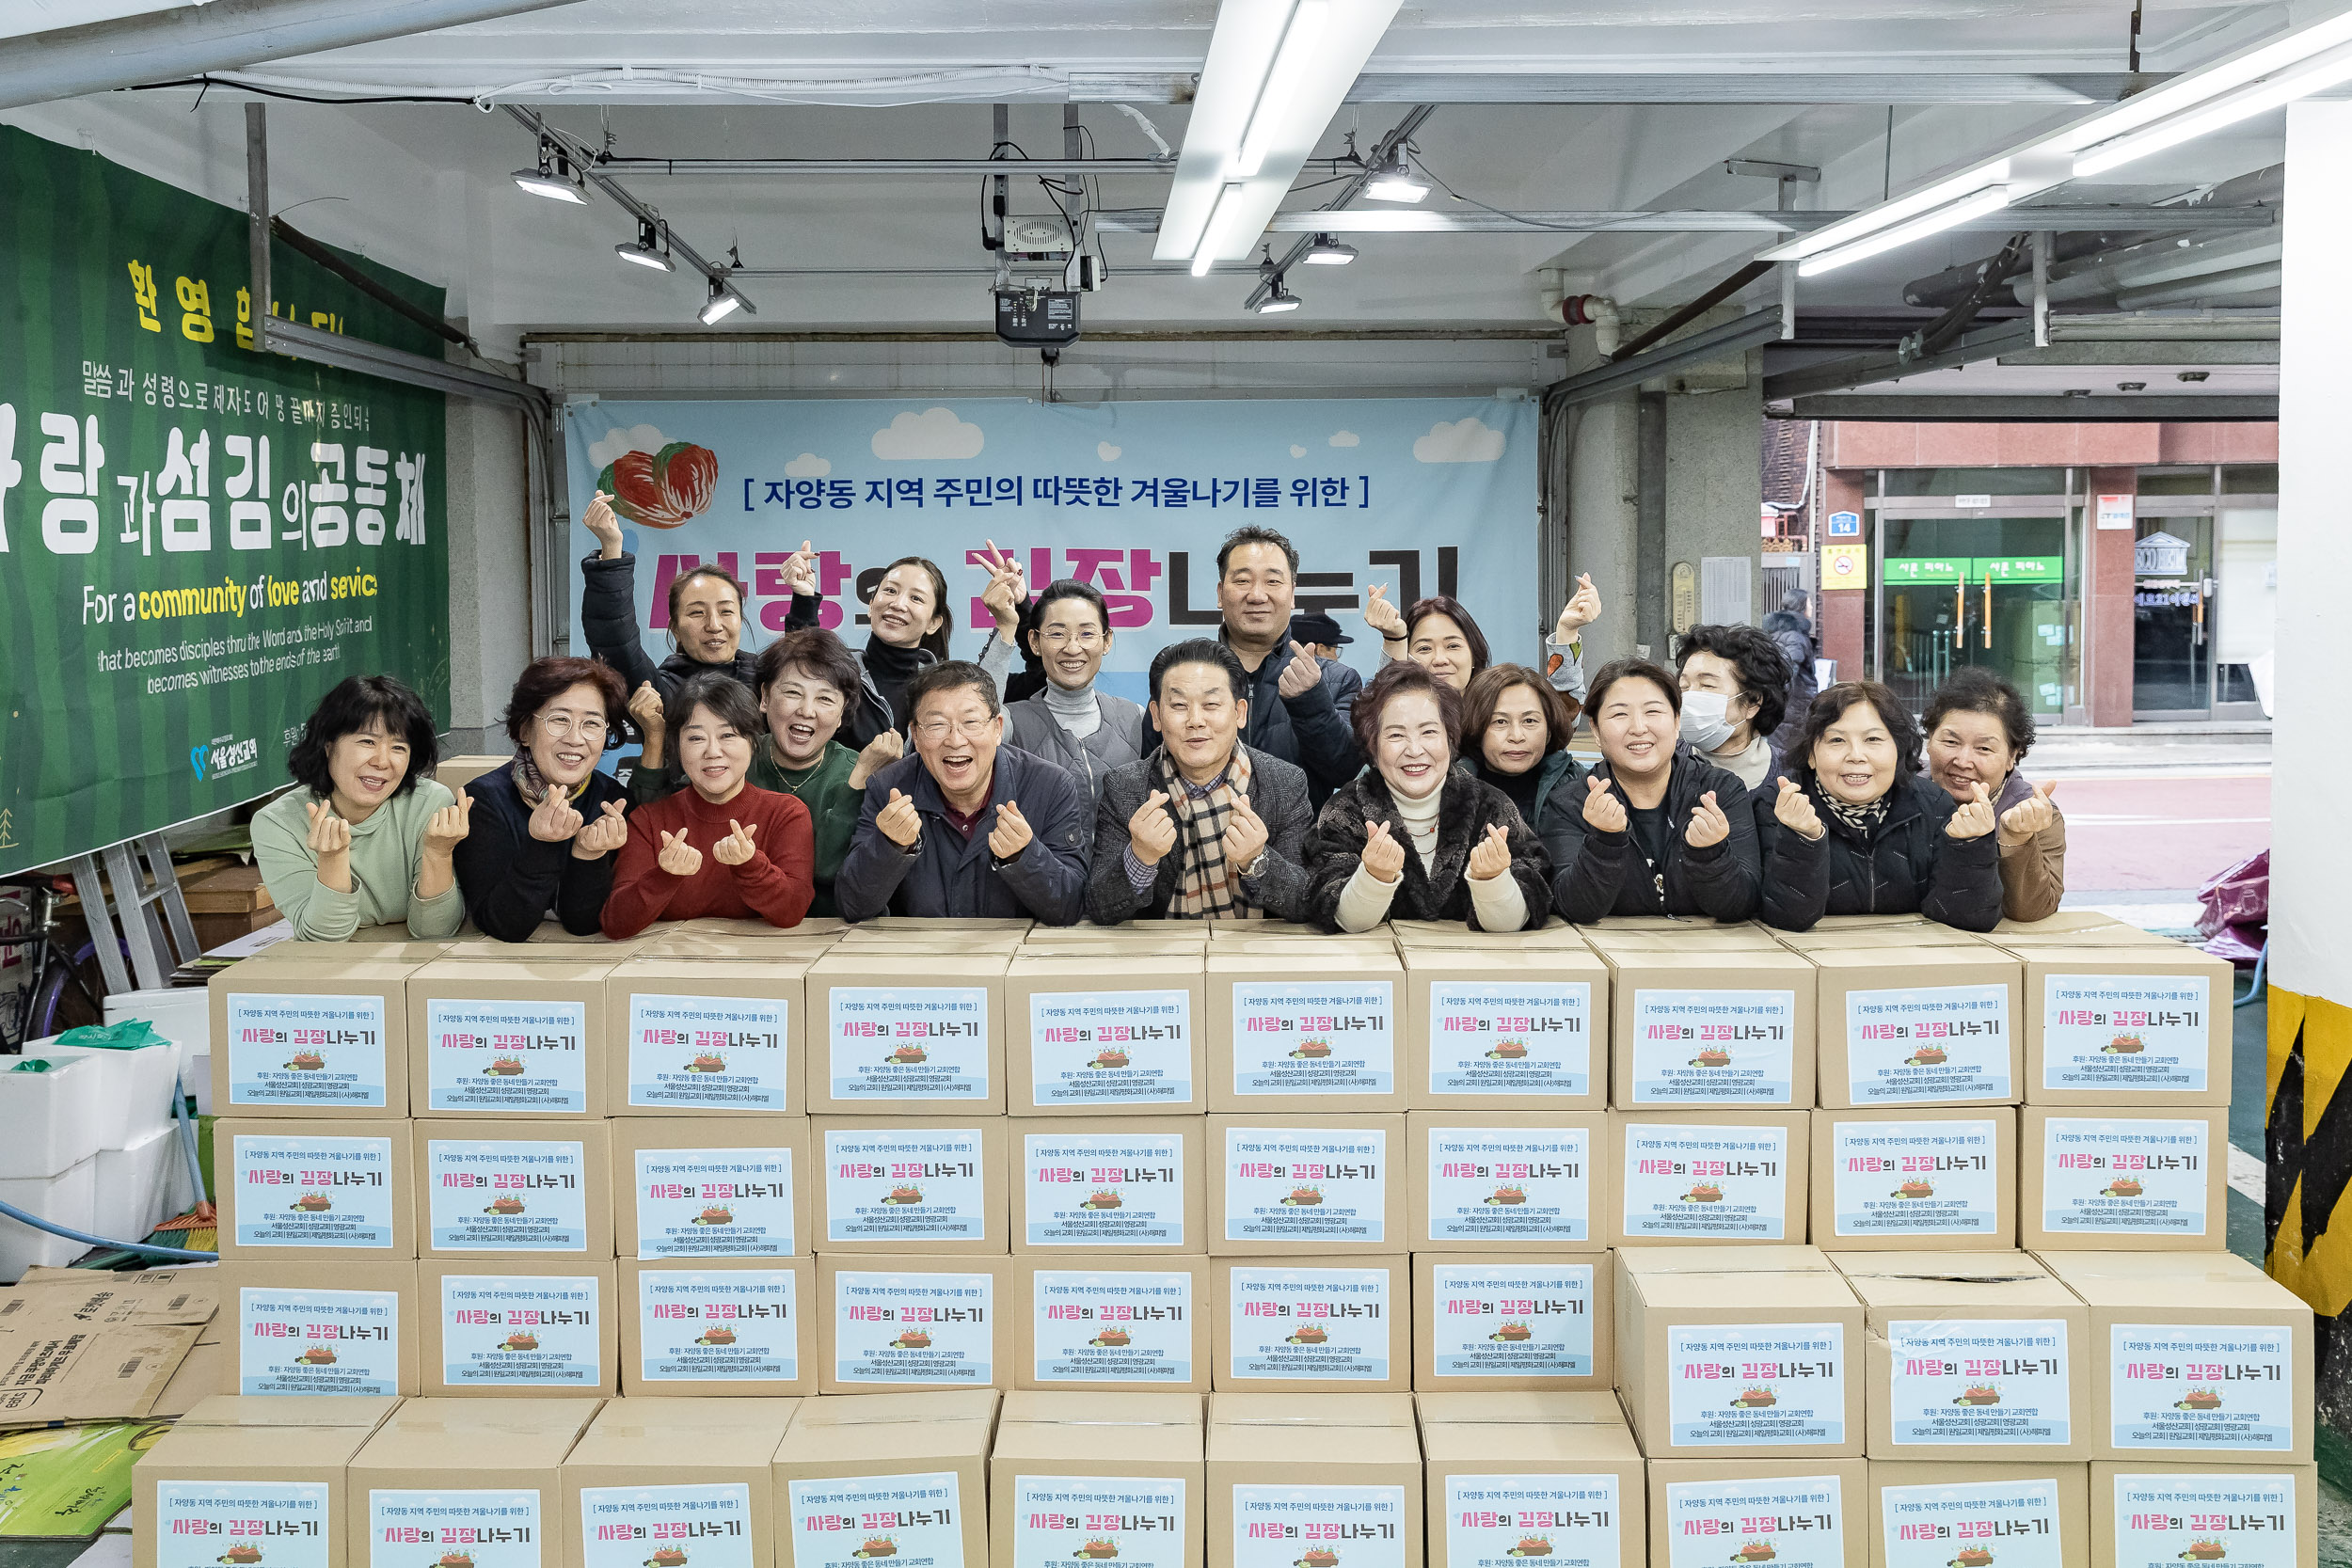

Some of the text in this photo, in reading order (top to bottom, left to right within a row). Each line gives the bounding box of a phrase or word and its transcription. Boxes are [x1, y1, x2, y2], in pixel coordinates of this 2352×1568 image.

[143, 372, 208, 411] 성령으로
[309, 442, 426, 548] 공동체
[764, 478, 857, 509] 자양동
[865, 477, 923, 508] 지역
[933, 476, 1023, 507] 주민의
[1033, 475, 1123, 507] 따뜻한
[1131, 477, 1281, 508] 겨울나기를
[1290, 477, 1349, 507] 위한
[1838, 523, 1851, 533] 14
[83, 585, 117, 626] For
[123, 592, 136, 622] a
[138, 576, 247, 621] community
[250, 575, 264, 610] of
[267, 575, 299, 607] love
[302, 570, 327, 603] and
[97, 650, 122, 673] that
[124, 647, 179, 670] becomes
[179, 637, 226, 662] disciples
[227, 635, 246, 655] thru
[247, 632, 261, 651] the
[262, 627, 285, 649] Word
[304, 624, 317, 641] the
[354, 615, 373, 633] and
[147, 673, 199, 694] becomes
[199, 662, 249, 686] witnesses
[250, 658, 260, 677] to
[260, 656, 274, 674] the
[307, 647, 321, 665] the
[243, 1008, 370, 1020] 자양동 지역 주민의 따뜻한 겨울나기를 위한
[2058, 1009, 2199, 1028] 사랑의 김장나누기
[843, 1021, 977, 1037] 사랑의 김장나누기
[1248, 1015, 1383, 1032] 사랑의 김장나누기
[1444, 1016, 1580, 1034] 사랑의 김장나누기
[1647, 1023, 1784, 1041] 사랑의 김장나누기
[1862, 1020, 1999, 1040] 사랑의 김장나누기
[242, 1028, 375, 1046] 사랑의 김장나누기
[644, 1028, 777, 1050] 사랑의 김장나누기
[1045, 1024, 1181, 1042] 사랑의 김장나누기
[1239, 1163, 1375, 1180] 사랑의 김장나누기
[1639, 1159, 1776, 1178] 사랑의 김장나누기
[2058, 1153, 2197, 1172] 사랑의 김장나누기
[248, 1169, 382, 1187] 사랑의 김장나누기
[1039, 1167, 1173, 1183] 사랑의 김장나누기
[650, 1182, 783, 1198] 사랑의 김장나누기
[654, 1303, 787, 1320] 사랑의 김장나누기
[1048, 1305, 1182, 1322] 사랑의 김장나누기
[1448, 1298, 1583, 1315] 사랑의 김장나누기
[254, 1322, 388, 1342] 사랑의 김장나누기
[1686, 1341, 1827, 1351] 자양동 지역 주민의 따뜻한 겨울나기를 위한
[1684, 1362, 1833, 1379] 사랑의 김장나누기
[1906, 1358, 2058, 1376] 사랑의 김장나누기
[2127, 1362, 2280, 1383] 사랑의 김장나누기
[6, 1392, 27, 1408] eats
[172, 1518, 318, 1538] 사랑의 김장나누기
[806, 1509, 950, 1531] 사랑의 김장나누기
[1684, 1513, 1832, 1535] 사랑의 김장나누기
[2131, 1513, 2284, 1532] 사랑의 김장나누기
[1248, 1522, 1394, 1541] 사랑의 김장나누기
